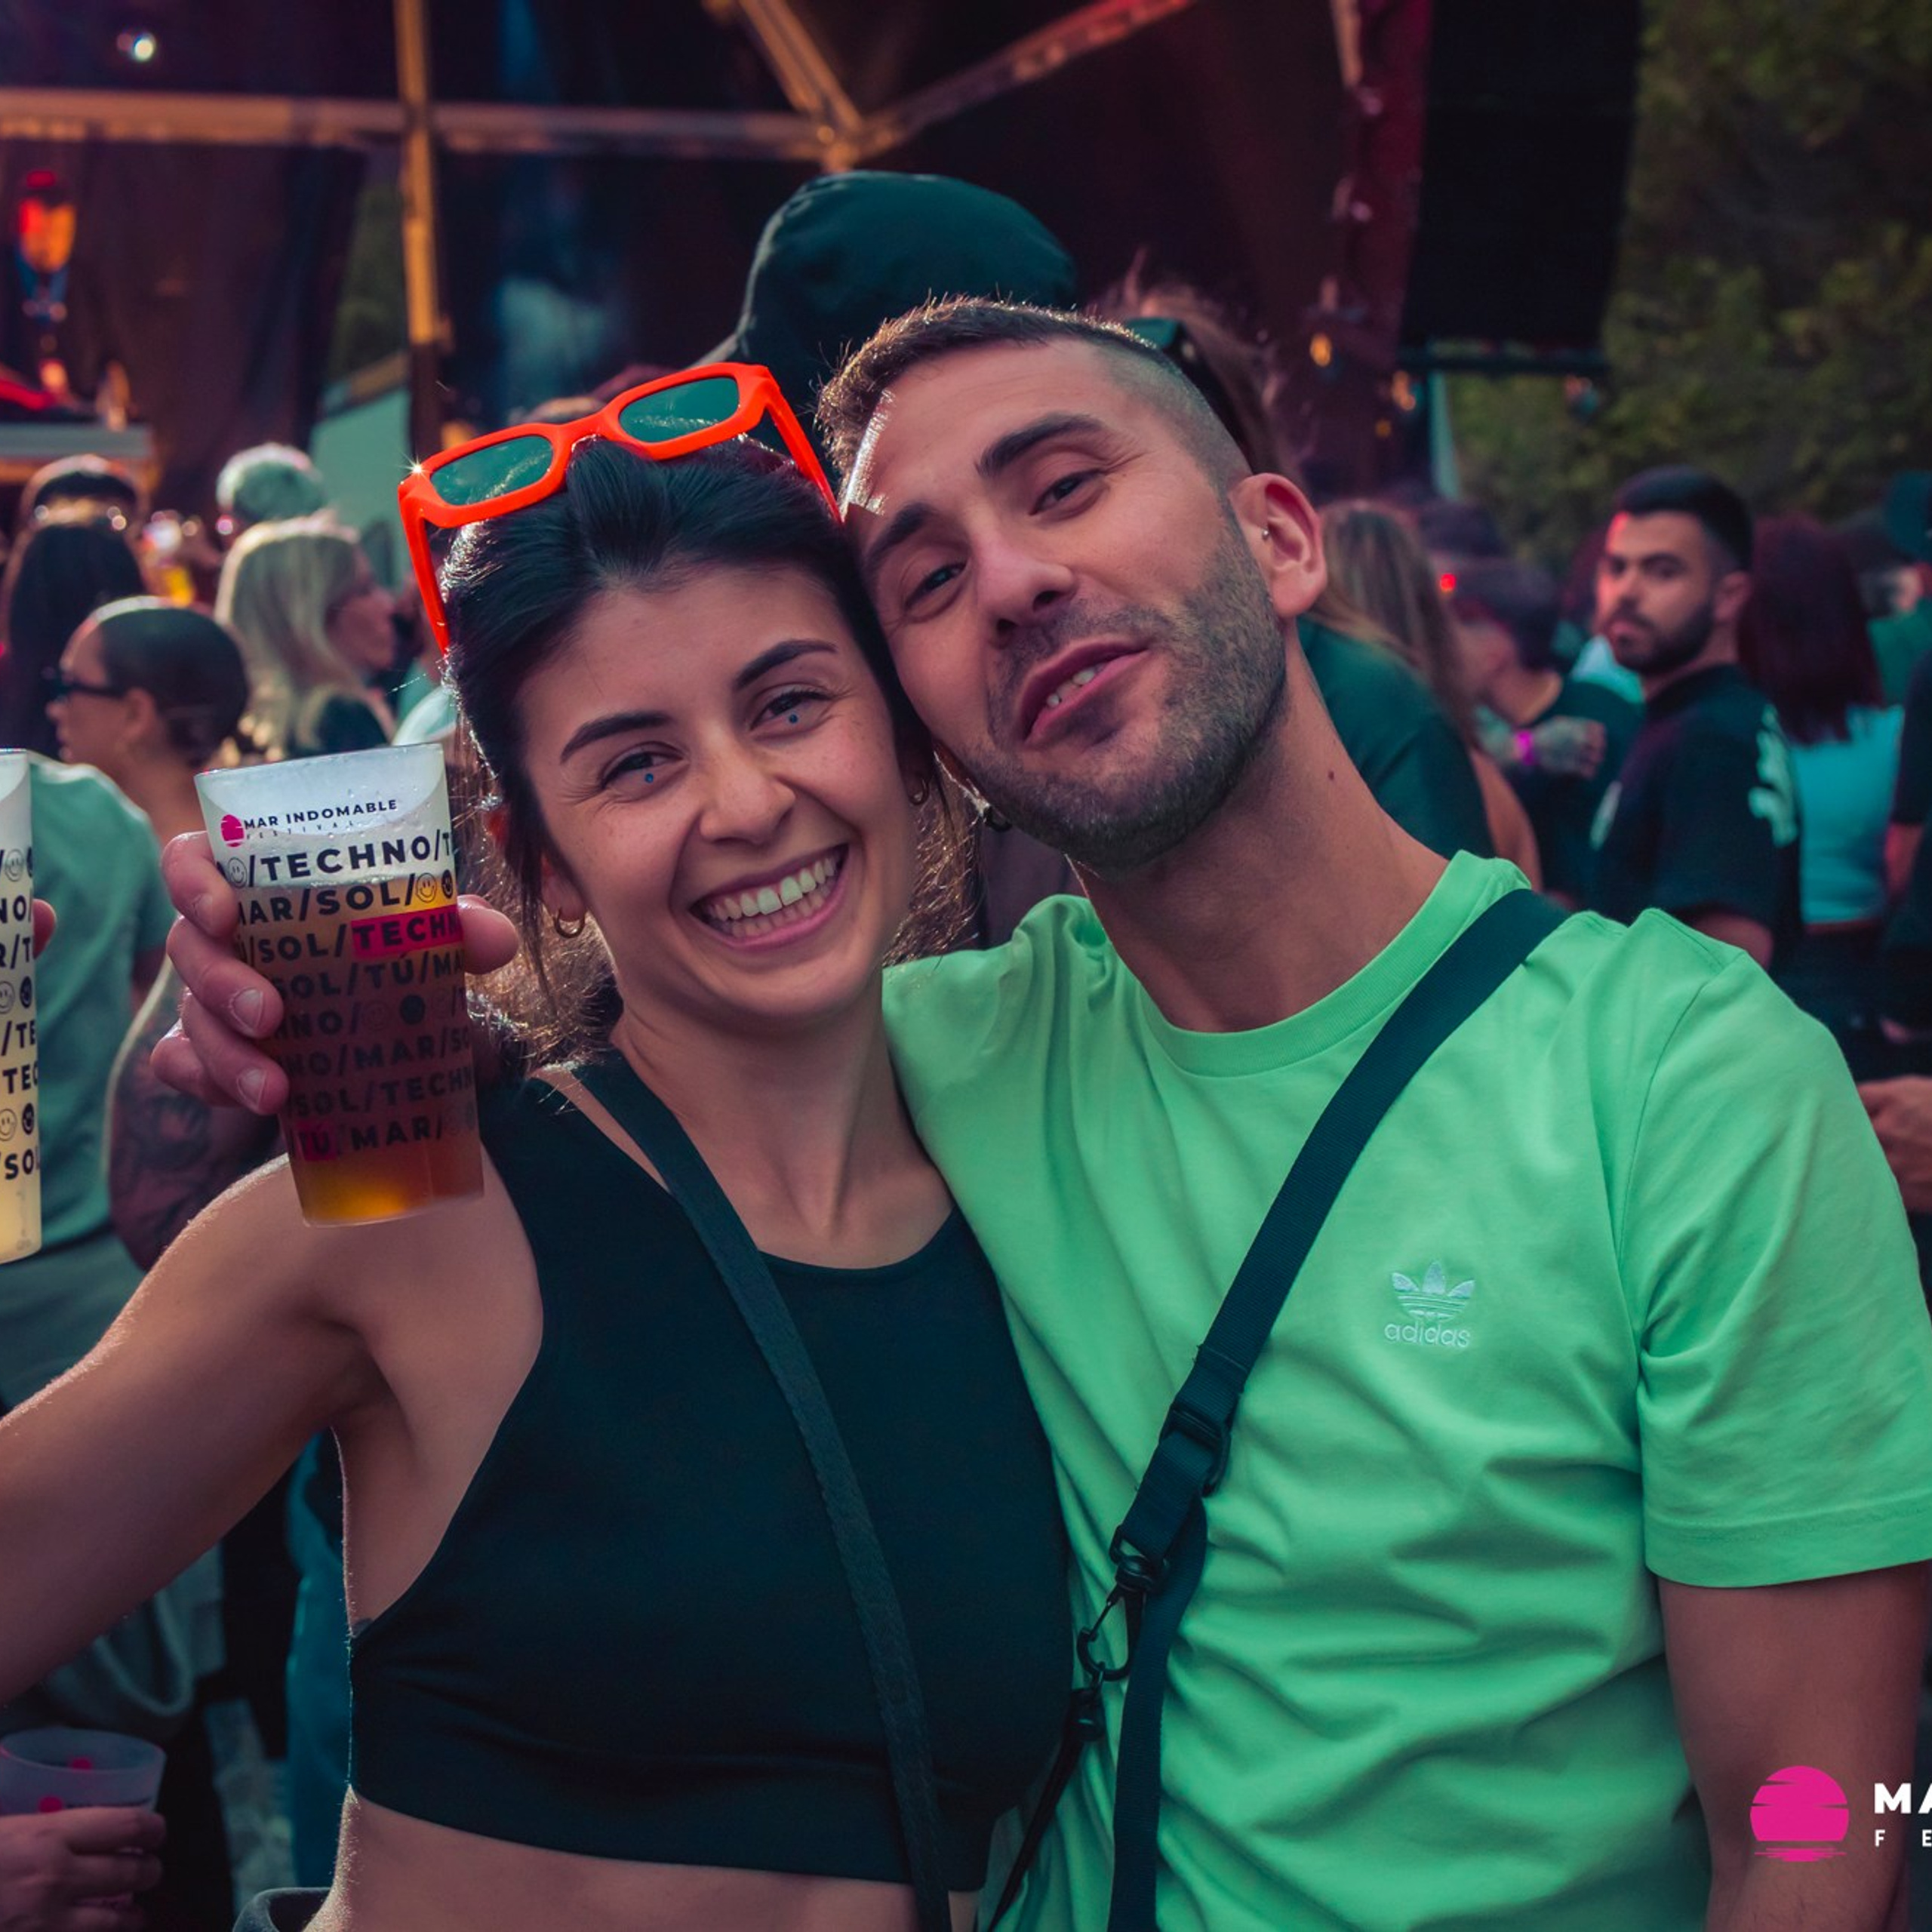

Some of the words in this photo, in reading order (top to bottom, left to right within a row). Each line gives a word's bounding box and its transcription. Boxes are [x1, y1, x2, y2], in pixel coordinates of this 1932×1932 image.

[244, 814, 278, 830] MAR
[286, 798, 398, 825] INDOMABLE
[1383, 1320, 1471, 1349] adidas
